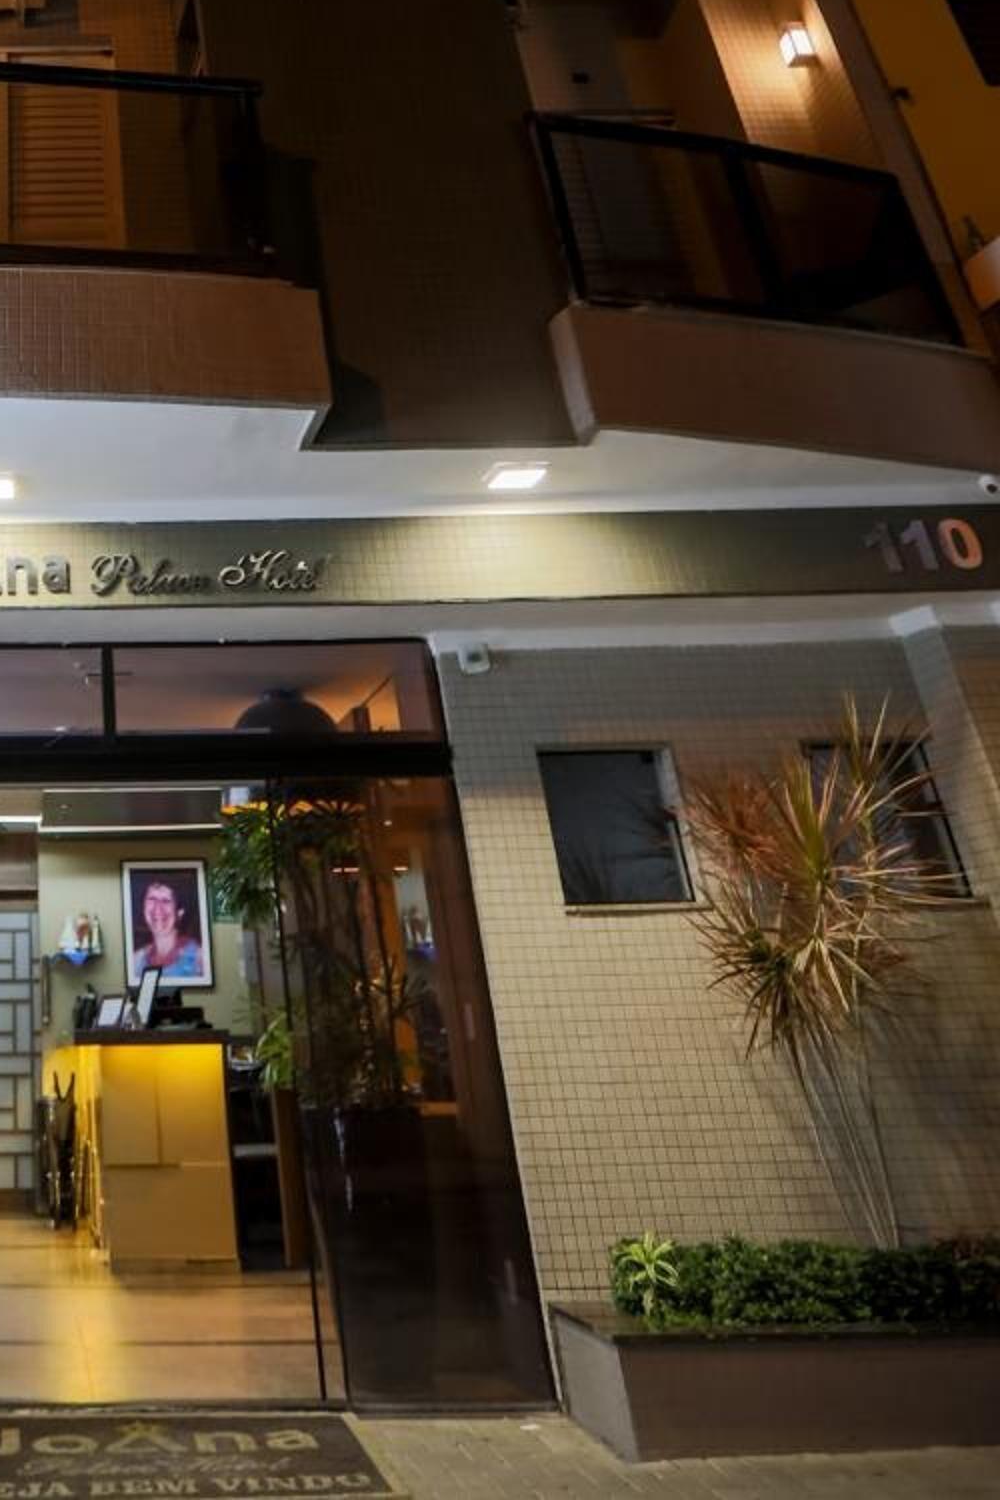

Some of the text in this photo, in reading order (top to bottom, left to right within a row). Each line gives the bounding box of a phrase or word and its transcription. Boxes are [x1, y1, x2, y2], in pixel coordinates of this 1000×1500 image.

[862, 517, 983, 573] 110
[89, 1474, 200, 1496] BEM
[213, 1472, 371, 1493] VINDO
